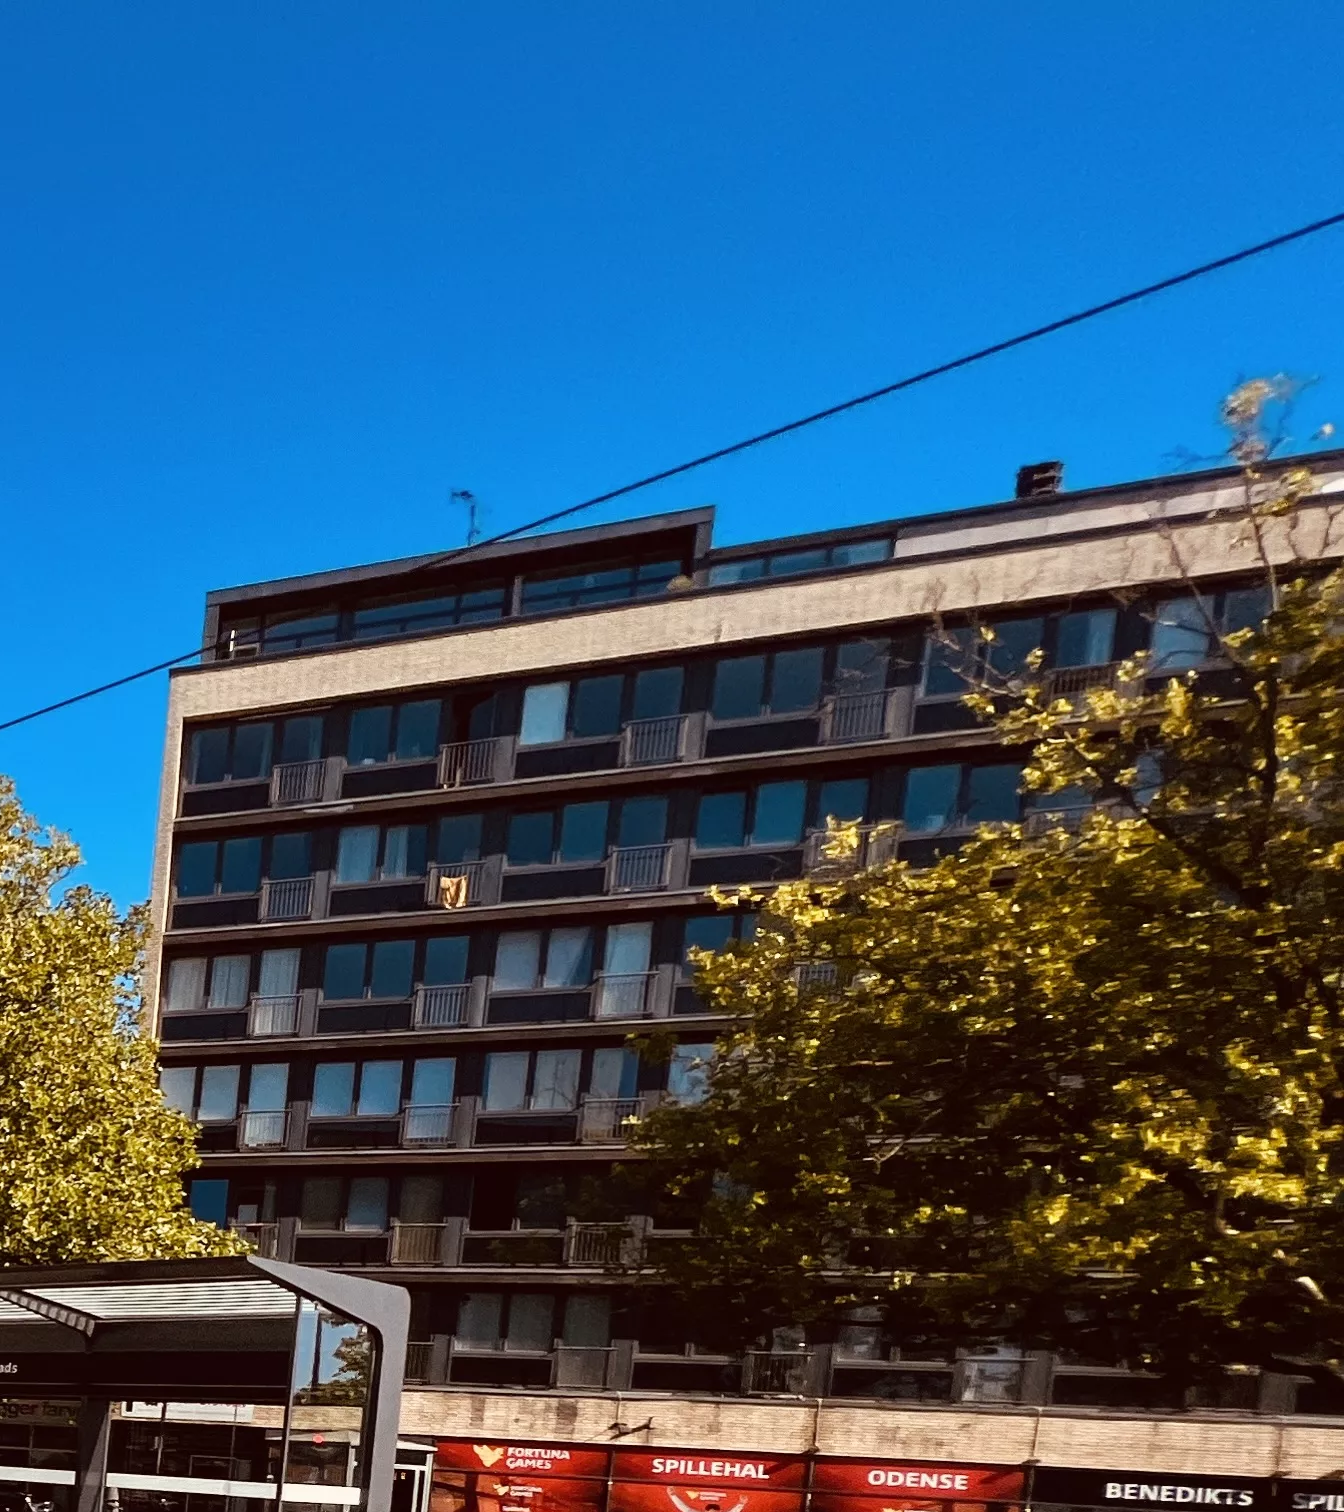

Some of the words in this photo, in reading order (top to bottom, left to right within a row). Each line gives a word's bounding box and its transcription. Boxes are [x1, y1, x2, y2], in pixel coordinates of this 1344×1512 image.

[505, 1458, 553, 1470] GAMES
[506, 1446, 571, 1460] FORTUNA
[651, 1458, 770, 1480] SPILLEHAL
[867, 1469, 969, 1491] ODENSE
[1105, 1482, 1255, 1507] BENEDIKTS
